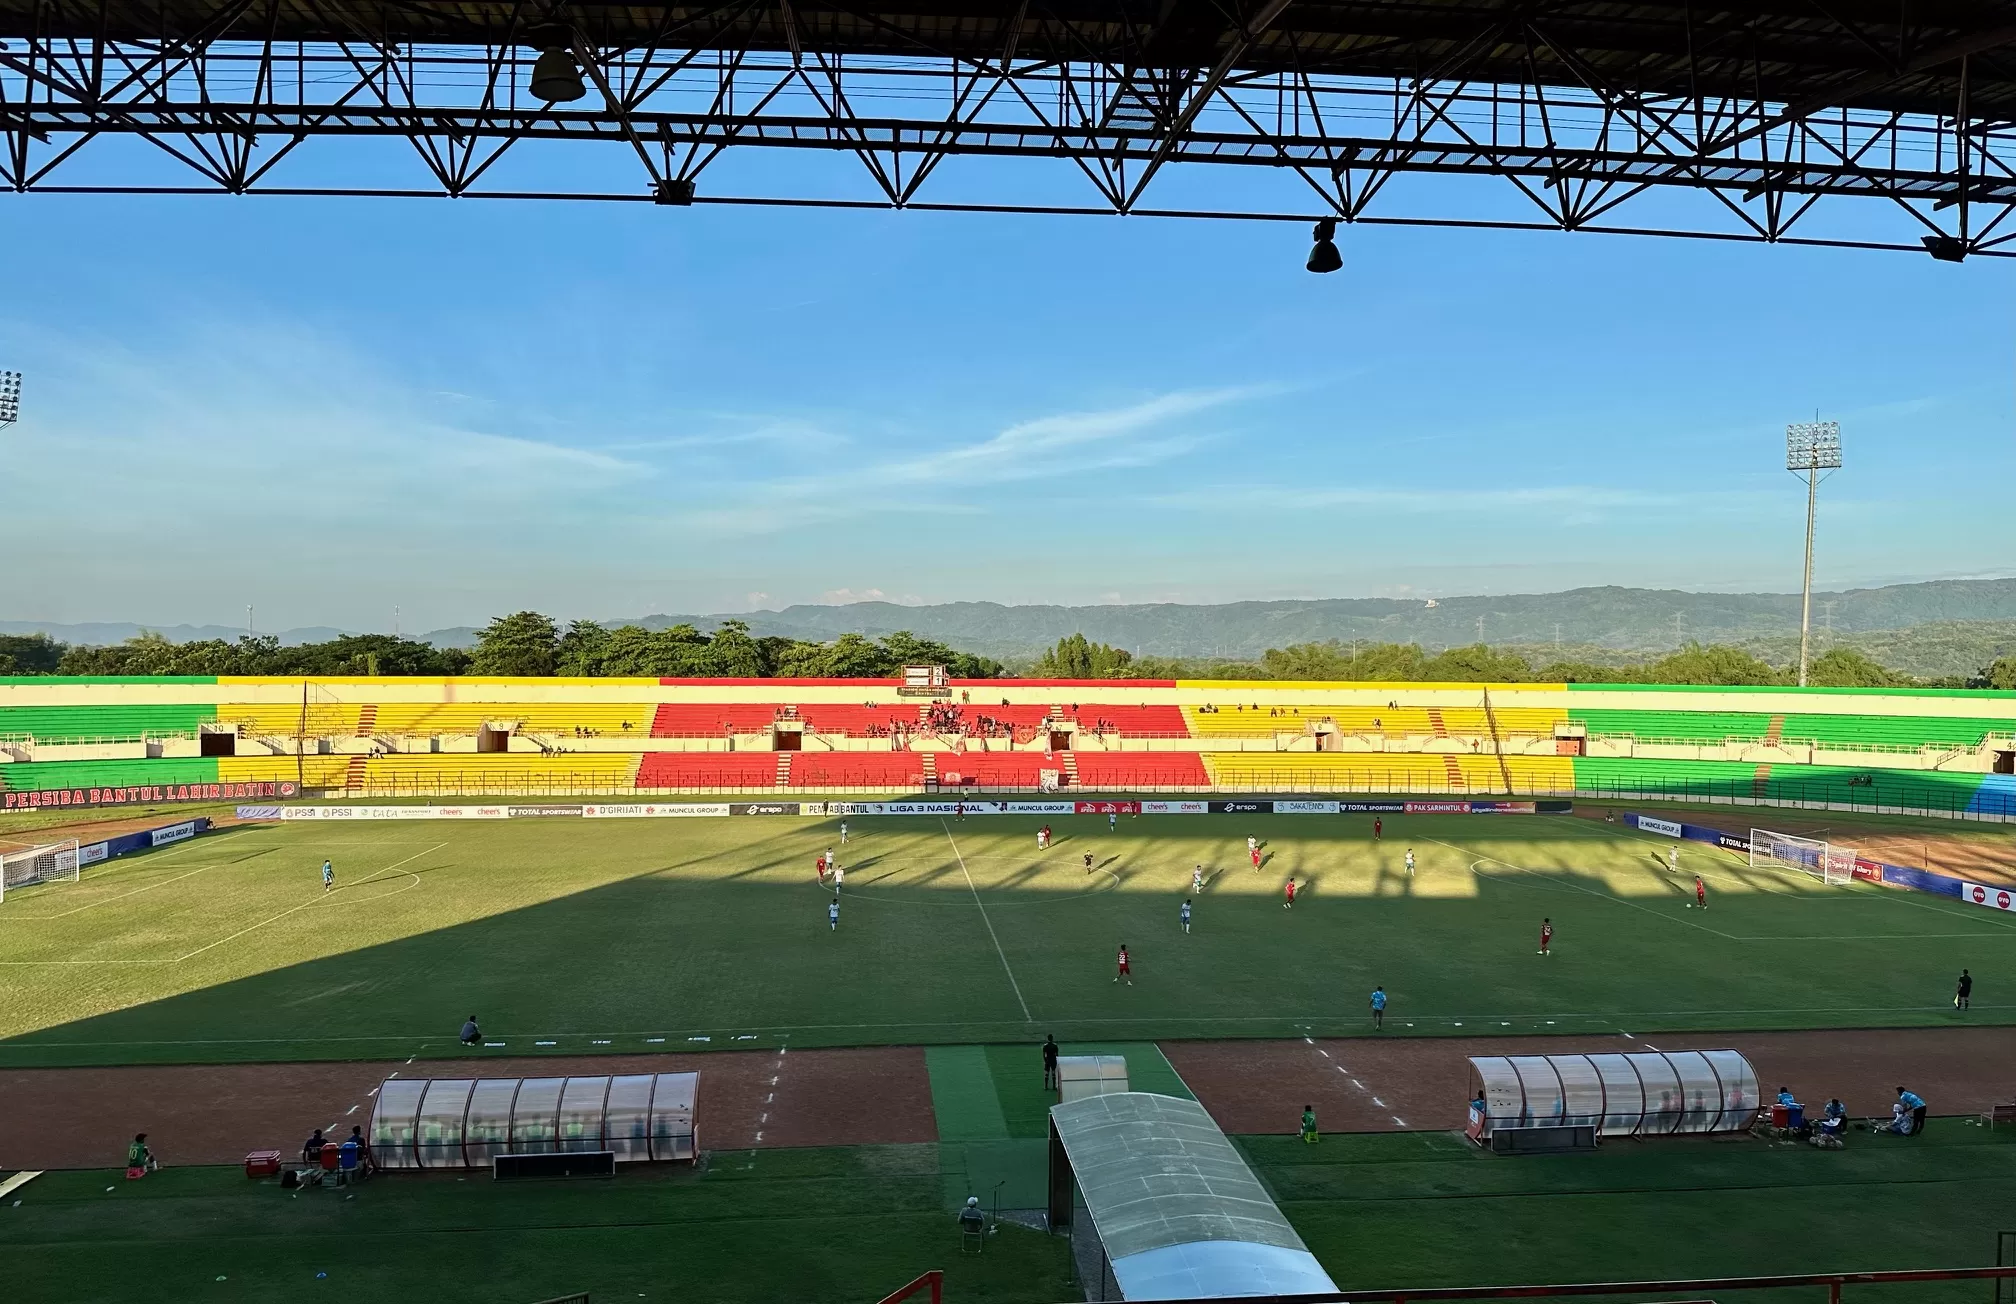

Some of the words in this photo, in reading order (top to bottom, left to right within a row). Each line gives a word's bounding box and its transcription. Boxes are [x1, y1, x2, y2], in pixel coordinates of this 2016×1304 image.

[5, 790, 85, 807] PERSIBA
[90, 787, 162, 803] BANTUL
[167, 785, 220, 800] LAHIR
[224, 783, 276, 798] BATIN
[294, 808, 316, 817] PSSI
[331, 808, 352, 817] PSSI
[841, 805, 870, 814] BANTUL
[1427, 804, 1461, 812] SARMINTUL
[1645, 822, 1661, 830] MUNCUL
[1661, 824, 1675, 832] GROUP
[159, 831, 175, 840] MUNCUL
[175, 828, 188, 836] GROUP
[1726, 838, 1742, 848] TOTAL
[1857, 865, 1873, 876] Glory
